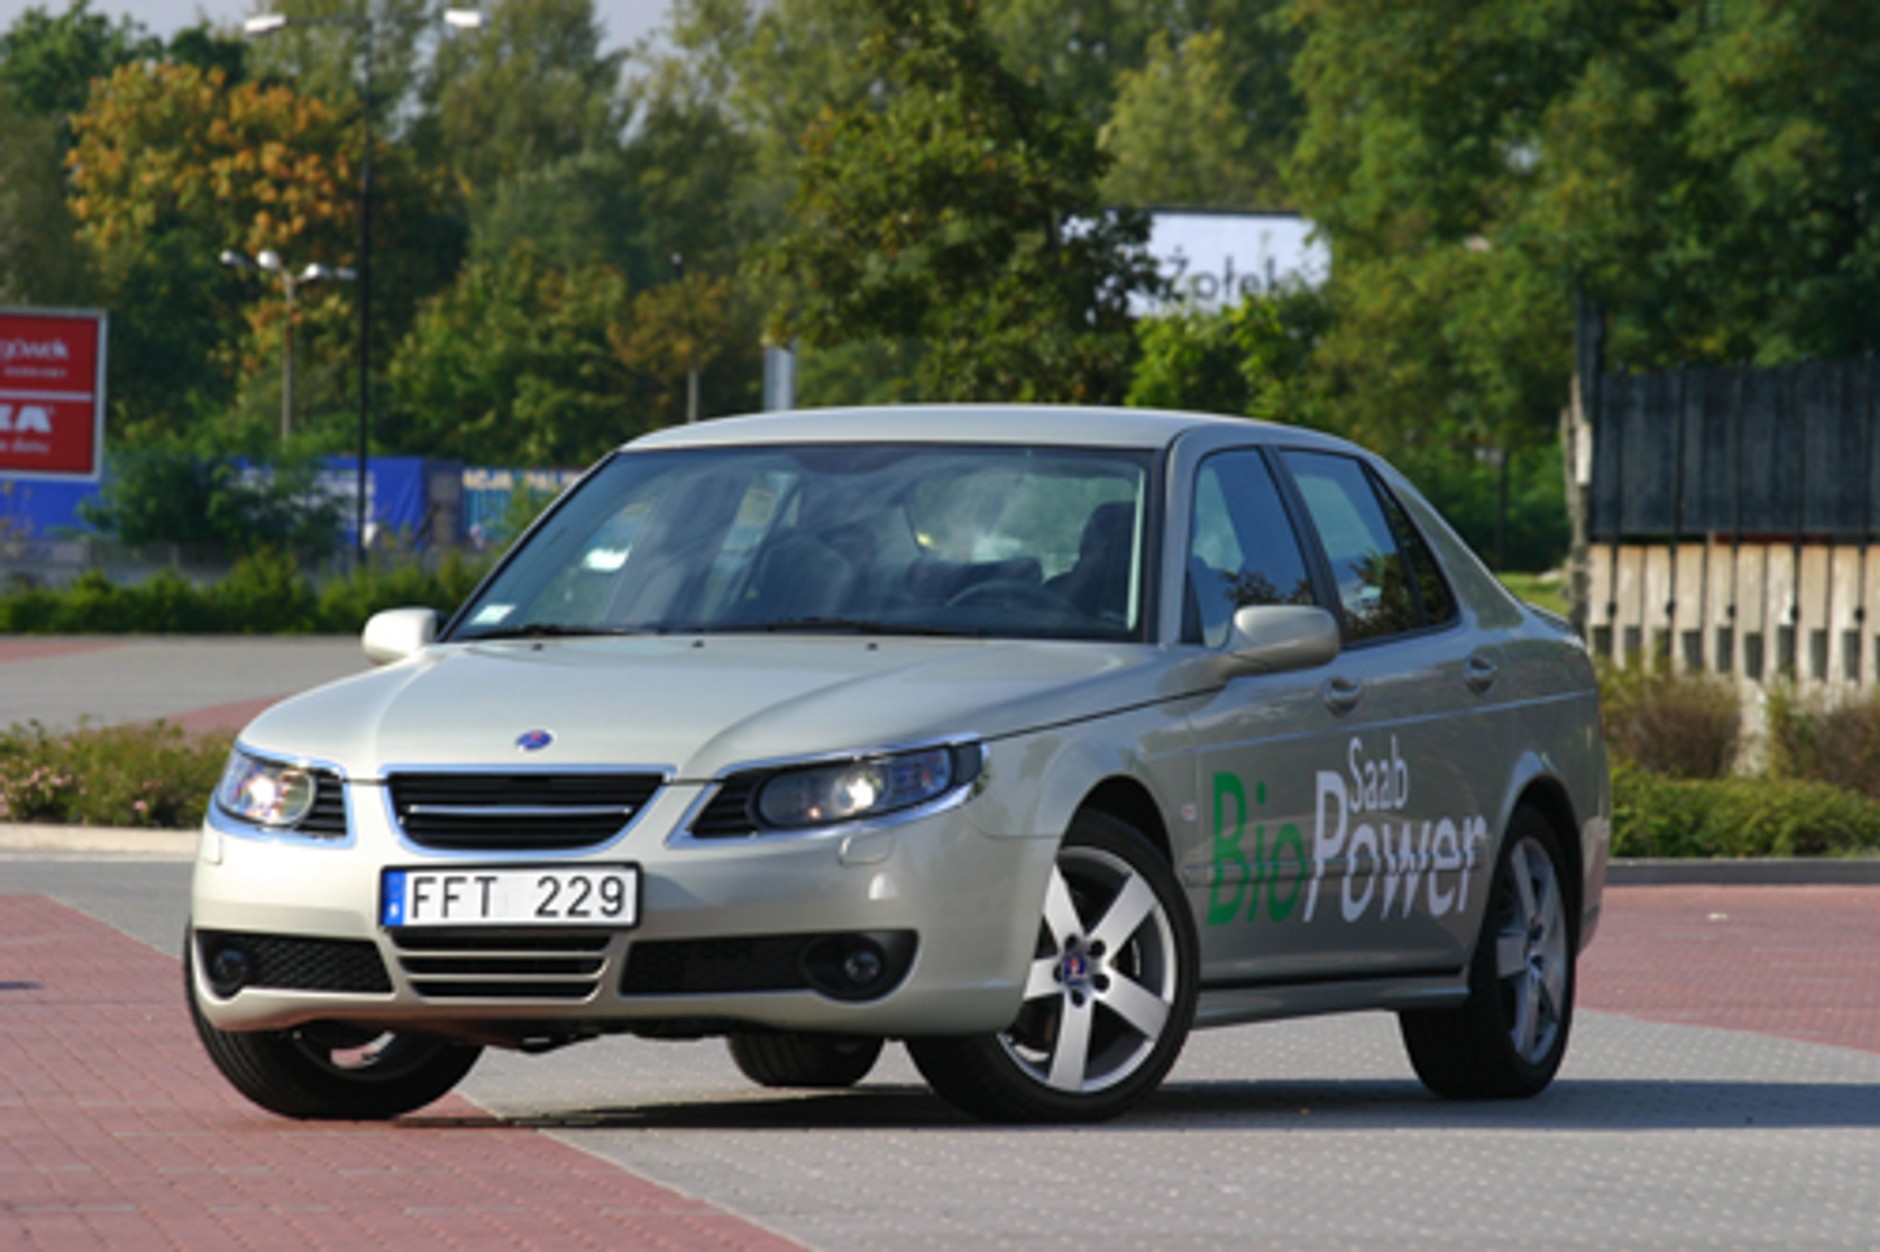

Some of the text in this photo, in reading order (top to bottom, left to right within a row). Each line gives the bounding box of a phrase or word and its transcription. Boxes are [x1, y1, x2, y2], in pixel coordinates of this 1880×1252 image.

[1347, 734, 1409, 813] Saab
[1207, 770, 1488, 926] BioPower
[412, 875, 626, 919] FFT 229
